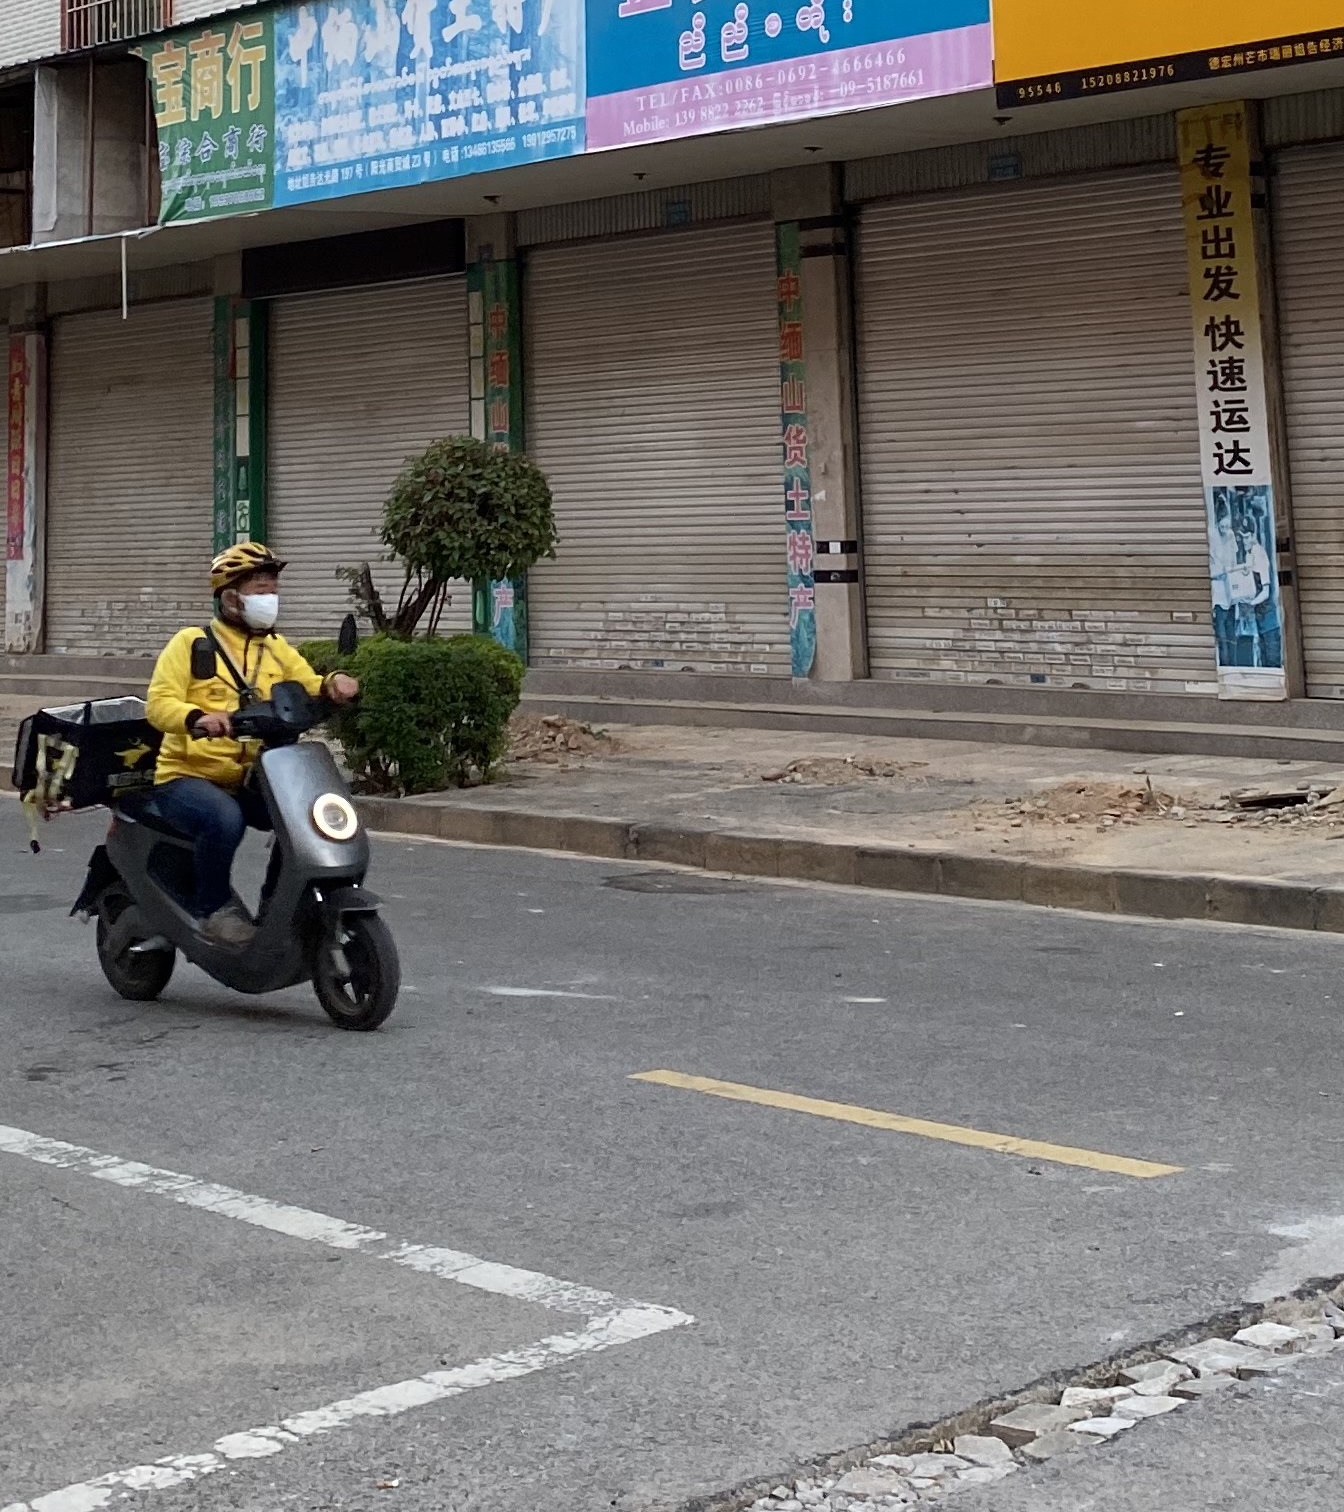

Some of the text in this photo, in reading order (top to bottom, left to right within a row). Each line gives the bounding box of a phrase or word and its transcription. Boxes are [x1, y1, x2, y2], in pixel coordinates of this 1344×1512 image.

[675, 109, 696, 127] 139
[1080, 64, 1175, 90] 15208821976
[1192, 142, 1241, 302] 专业出发
[777, 269, 816, 628] 中缅山货土特产
[1204, 313, 1254, 476] 快速运达
